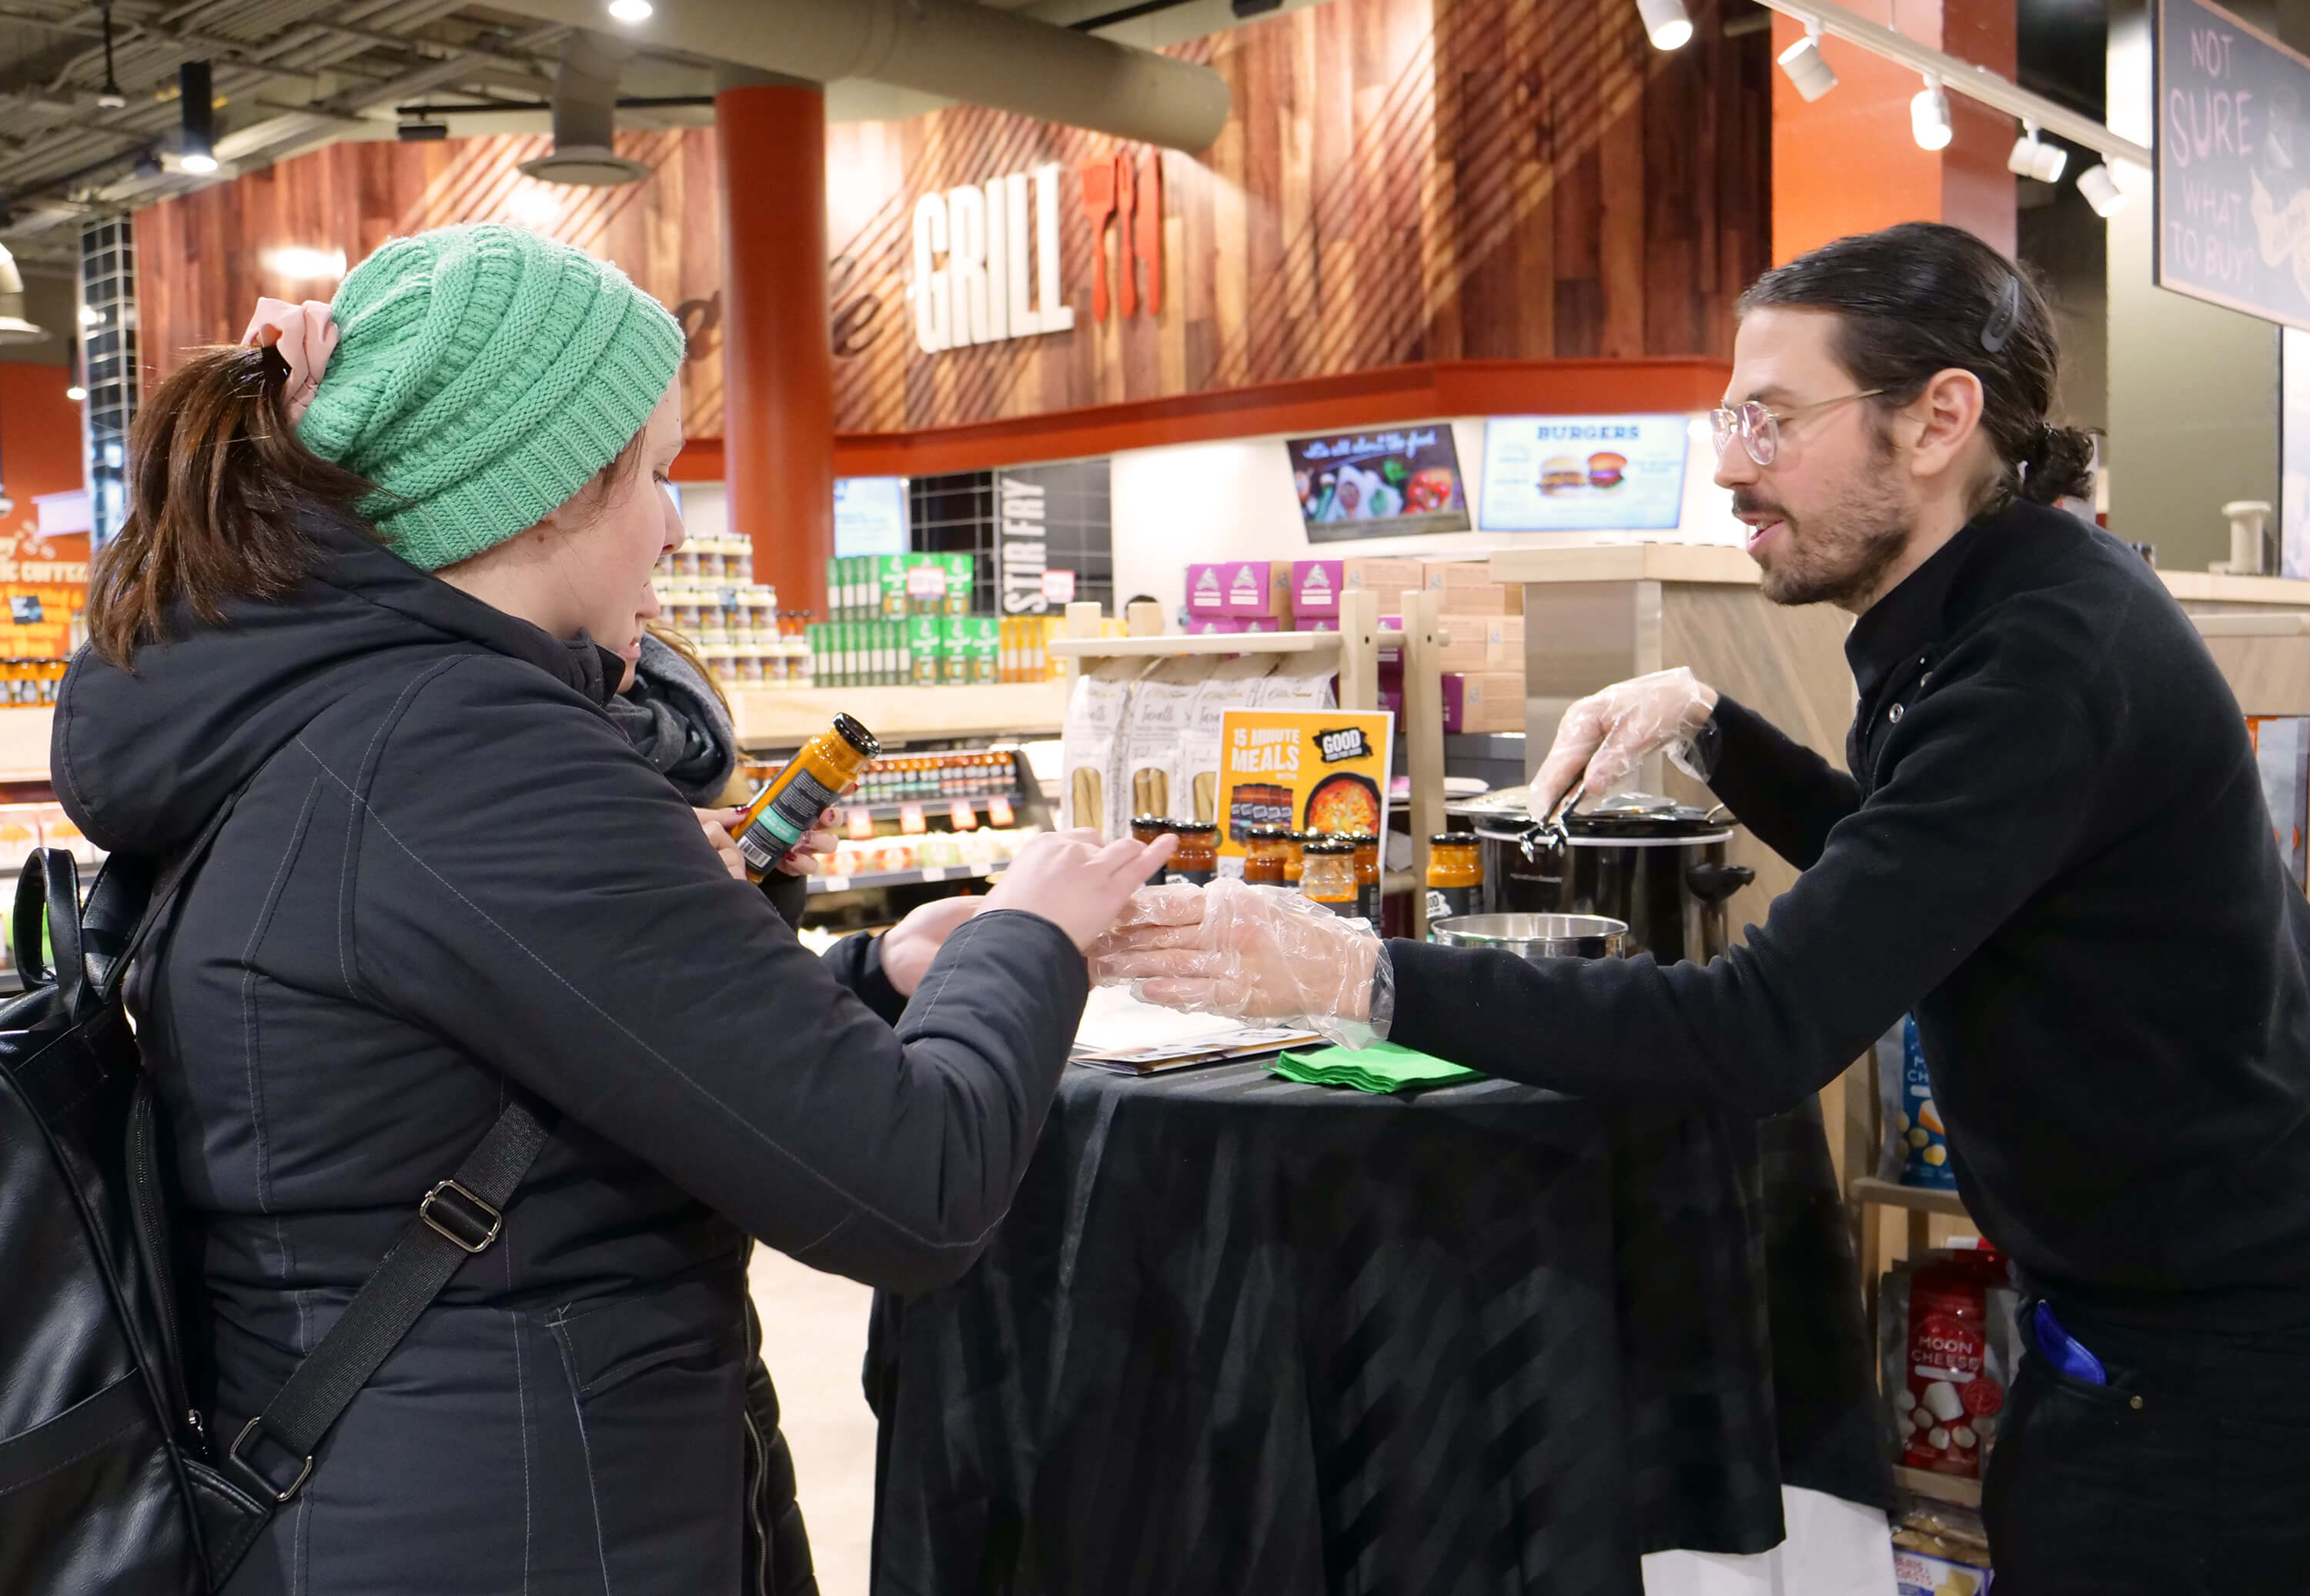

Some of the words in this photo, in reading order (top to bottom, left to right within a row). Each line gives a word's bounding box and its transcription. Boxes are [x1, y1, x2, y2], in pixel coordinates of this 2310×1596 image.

[2191, 28, 2233, 78] NOT
[2169, 87, 2252, 168] SURE
[2182, 171, 2241, 234] WHAT
[912, 161, 1075, 354] GRILL
[2171, 219, 2199, 272] TO
[1537, 425, 1640, 441] BURGERS
[1001, 477, 1046, 536] FRY
[1003, 541, 1048, 613] STIR
[1232, 744, 1300, 772] MEALS
[1234, 728, 1248, 746] 15
[1252, 729, 1300, 746] MINUTE
[1322, 729, 1361, 754] GOOD
[1911, 1349, 1980, 1370] CHEESE
[1918, 1336, 1973, 1354] MOON
